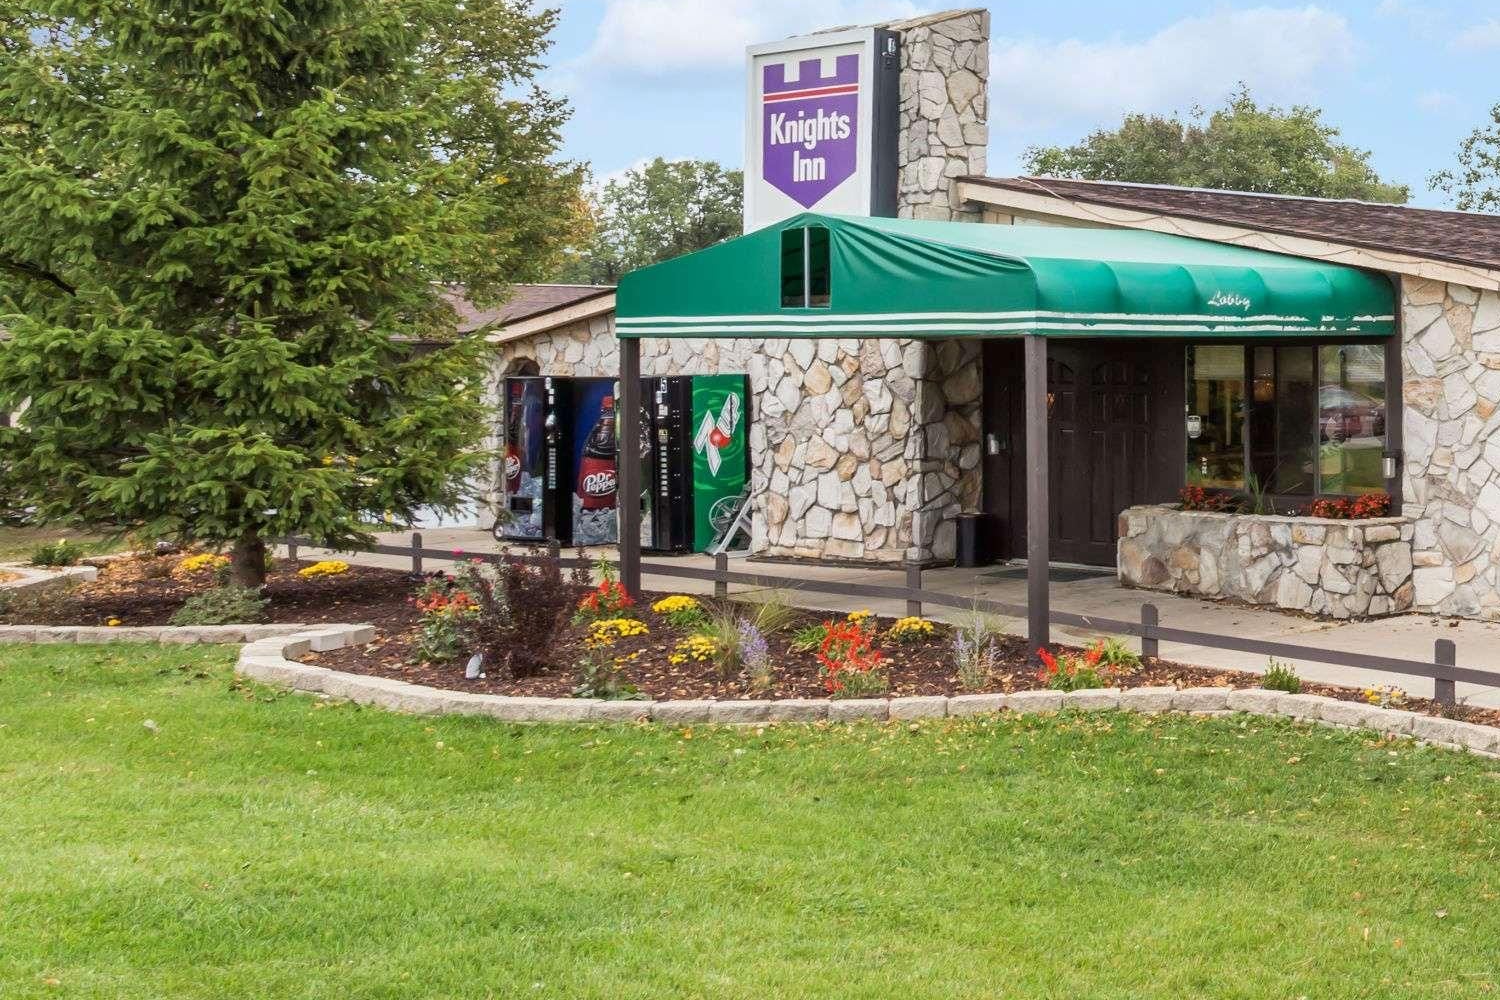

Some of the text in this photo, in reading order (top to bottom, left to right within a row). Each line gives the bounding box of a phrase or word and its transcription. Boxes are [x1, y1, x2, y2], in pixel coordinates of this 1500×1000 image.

[770, 109, 851, 150] Knights
[793, 150, 826, 182] Inn
[1207, 290, 1250, 311] Lobby
